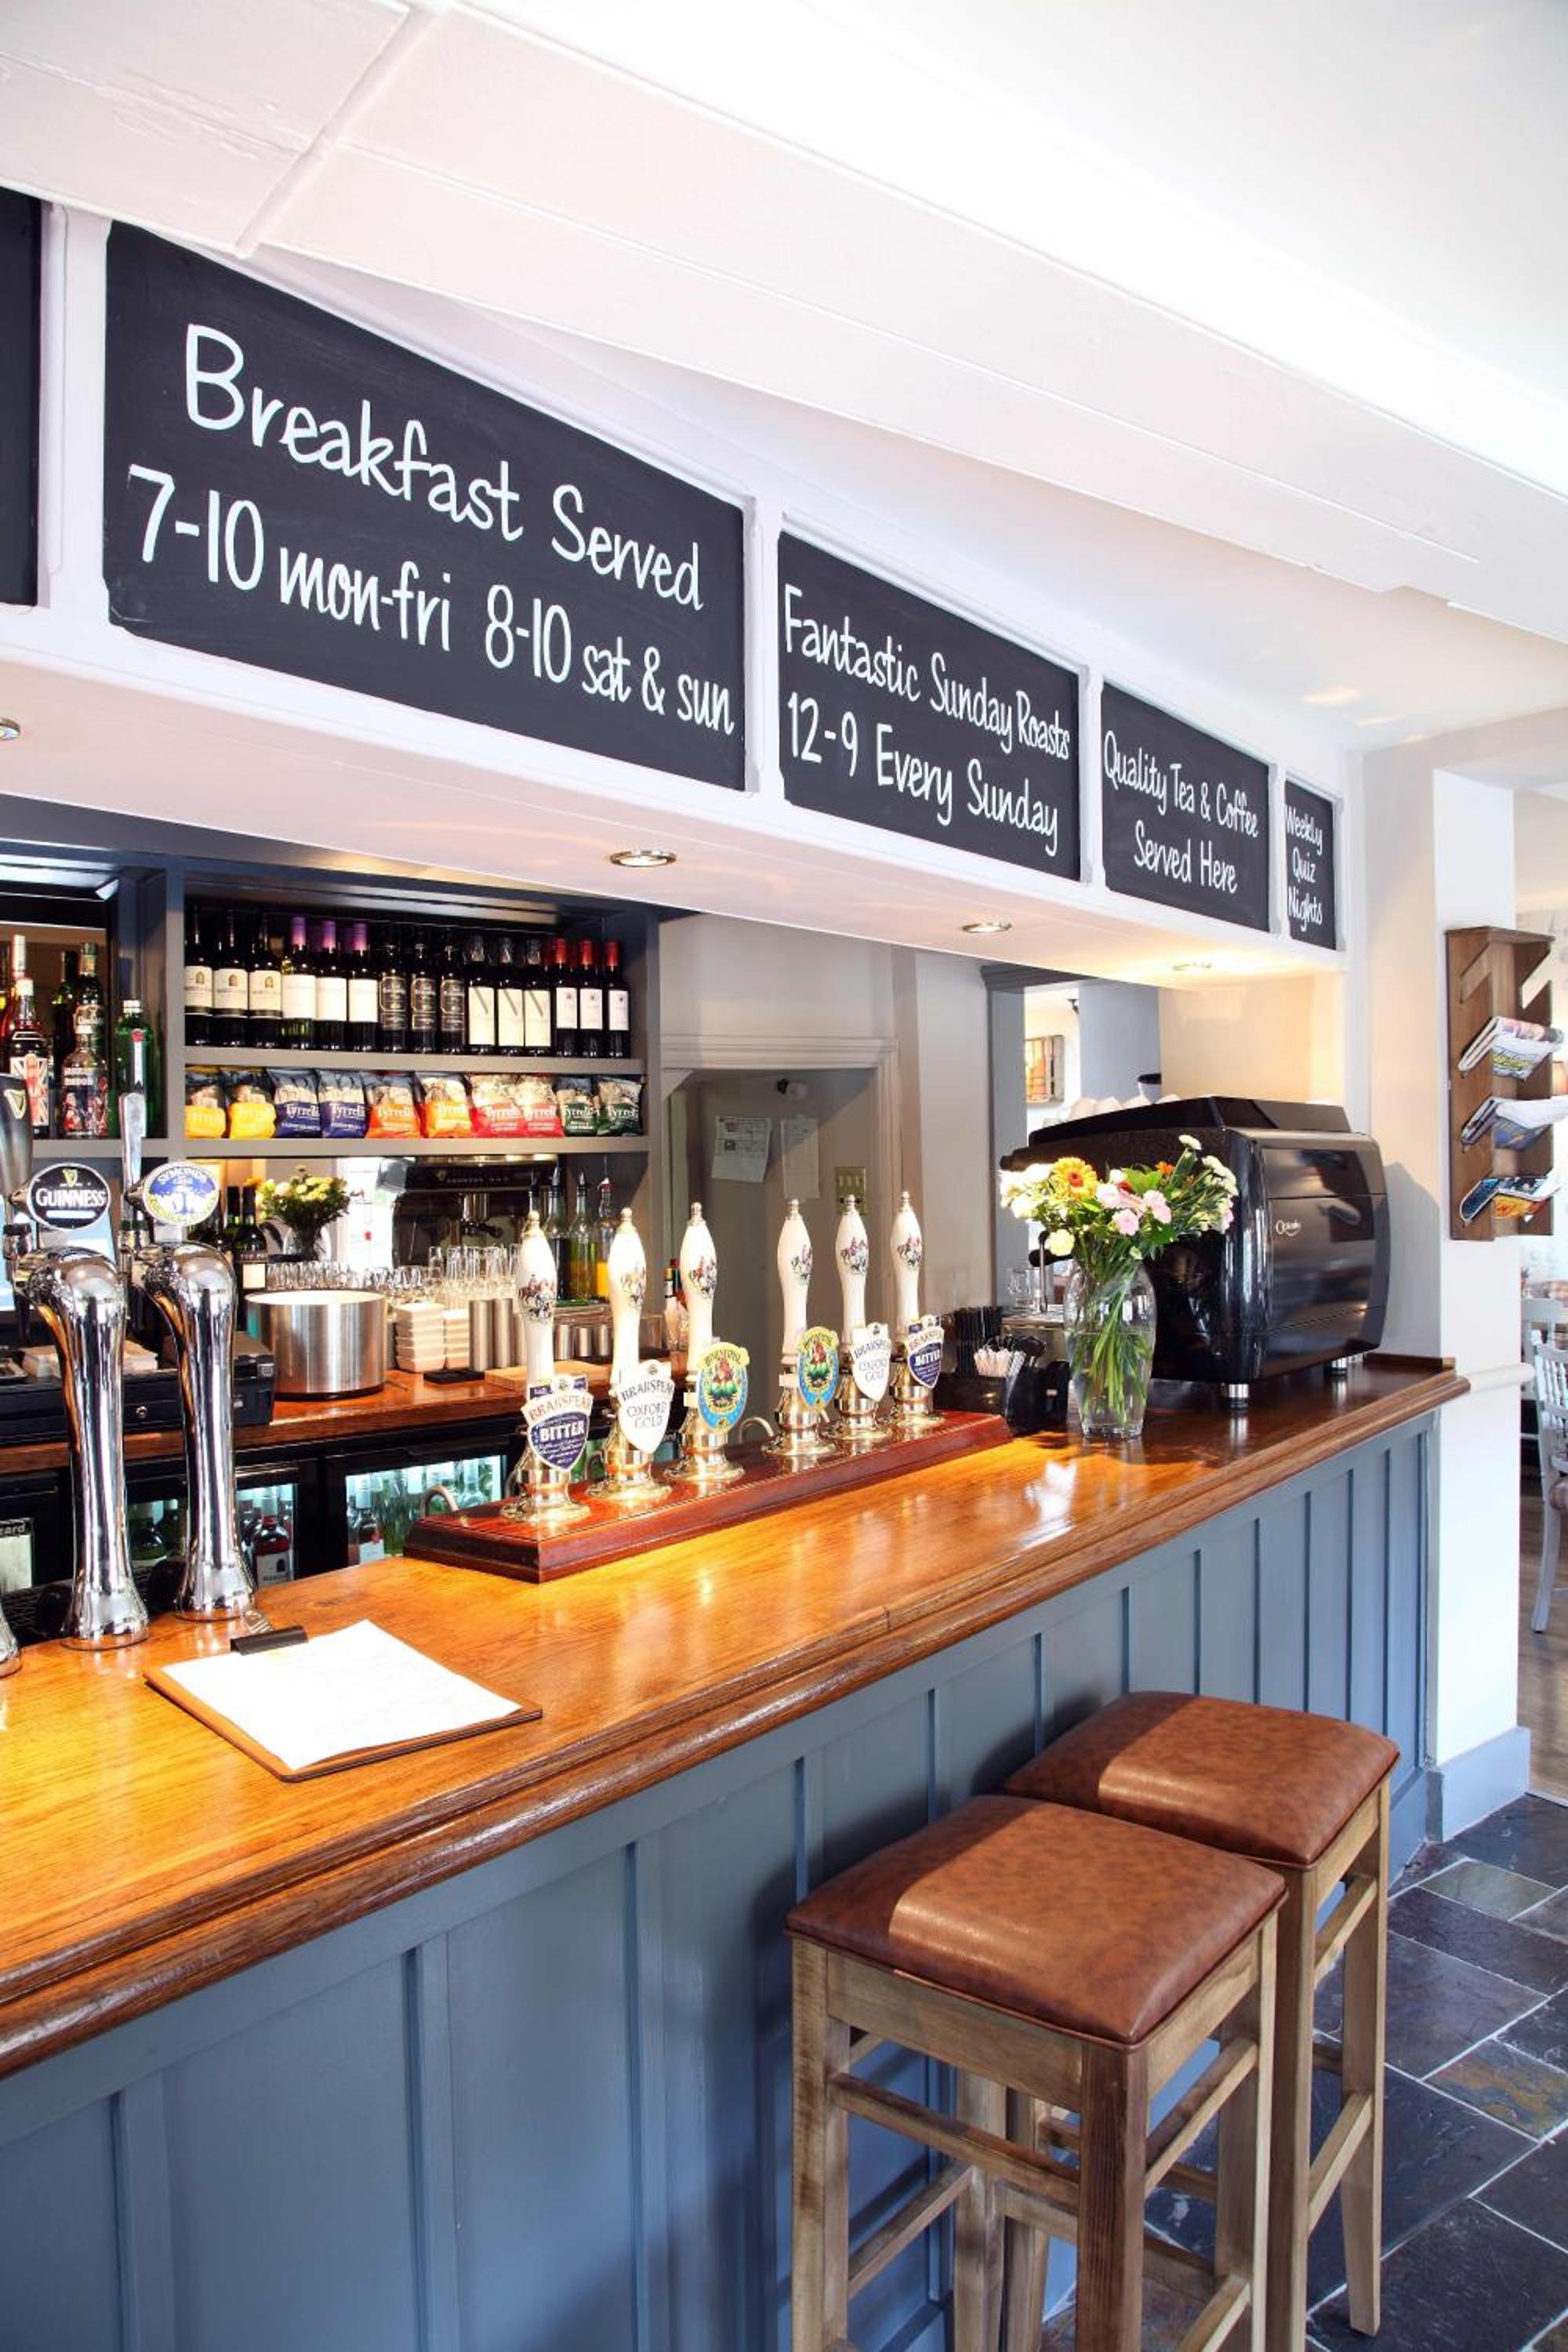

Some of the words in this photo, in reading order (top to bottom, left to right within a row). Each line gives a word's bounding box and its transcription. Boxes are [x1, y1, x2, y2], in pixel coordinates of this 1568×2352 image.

[186, 323, 524, 542] Breakfast
[551, 484, 703, 611] Served
[129, 463, 264, 590] 7-10
[280, 546, 452, 652] mon-fri
[485, 584, 572, 684] 8-10
[581, 636, 632, 703] sat
[641, 646, 666, 716] &
[677, 673, 735, 735] sun
[784, 583, 921, 702] Fantastic
[930, 652, 1013, 754] Sunday
[1015, 689, 1070, 760] Roasts
[787, 691, 858, 777] 12-9
[877, 723, 953, 826] Every
[967, 758, 1058, 857] Sunday
[1104, 730, 1167, 816] Quality
[1169, 763, 1195, 814] Tea
[1200, 782, 1211, 822] &
[1216, 782, 1258, 838] Coffee
[1134, 819, 1192, 883] Served
[1200, 840, 1238, 894] Here
[1283, 804, 1323, 856] Weekly
[1292, 846, 1316, 884] Quiz
[1288, 885, 1323, 931] Nights
[35, 1187, 106, 1207] GUINNESS
[539, 1420, 585, 1443] BITTER
[626, 1400, 667, 1417] OXFORD
